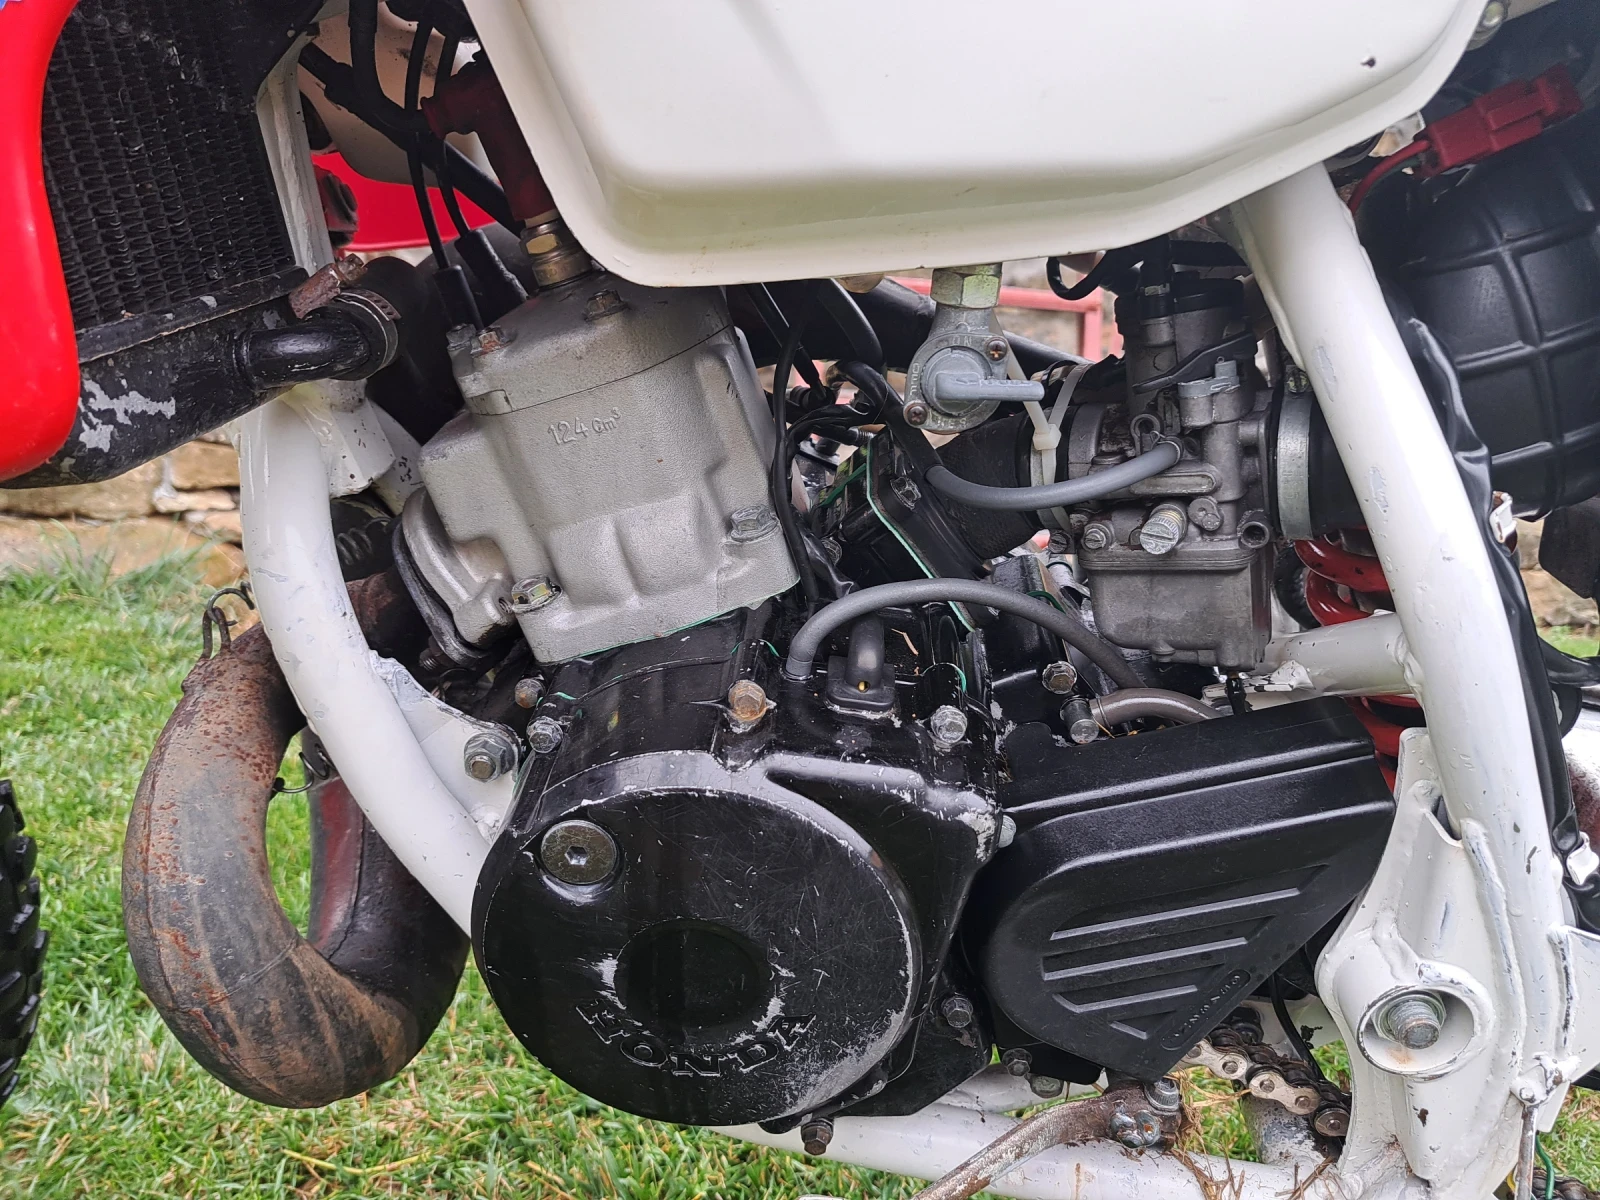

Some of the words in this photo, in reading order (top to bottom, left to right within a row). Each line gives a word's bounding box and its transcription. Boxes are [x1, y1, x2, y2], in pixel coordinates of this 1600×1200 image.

[952, 335, 972, 347] ON
[909, 362, 920, 396] OFF
[546, 416, 589, 446] 124
[575, 999, 817, 1077] HONDA
